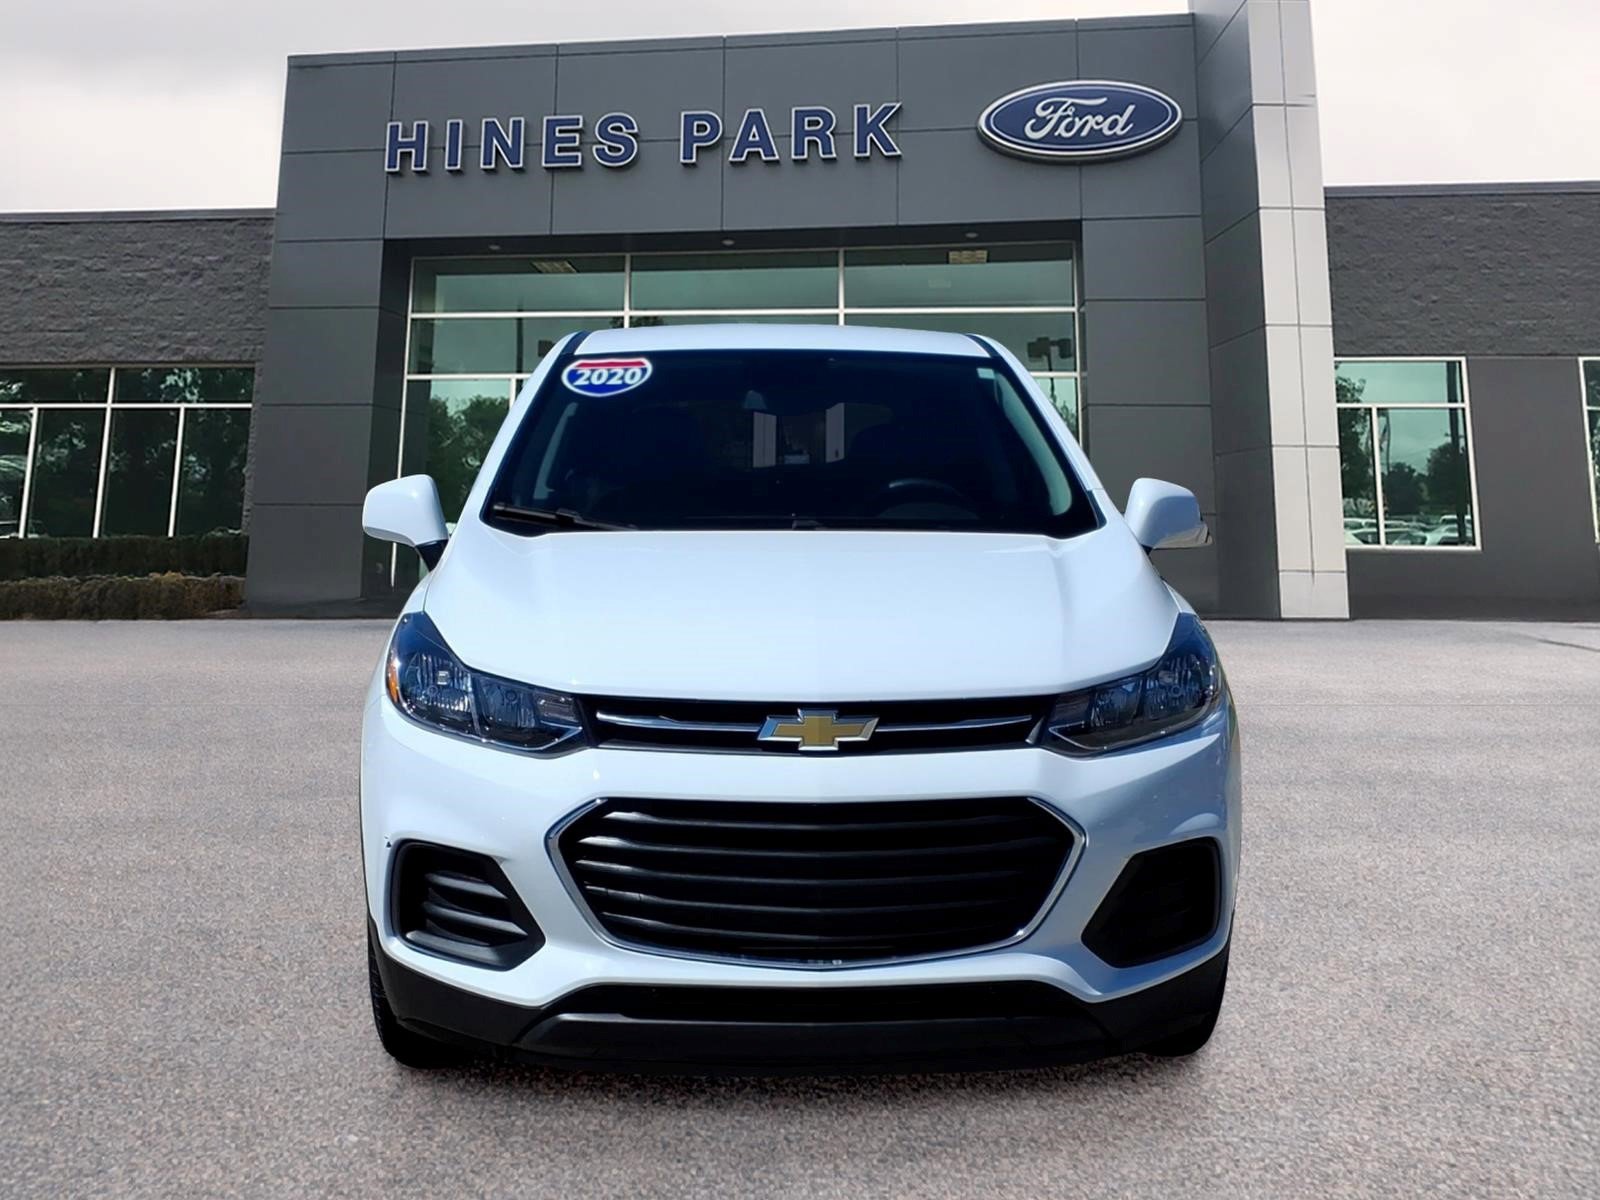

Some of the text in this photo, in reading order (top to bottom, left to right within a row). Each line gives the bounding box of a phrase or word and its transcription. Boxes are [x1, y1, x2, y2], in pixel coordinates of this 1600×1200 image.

[384, 102, 902, 172] HINES PARK
[1024, 97, 1136, 140] Ford
[573, 368, 642, 386] 2020
